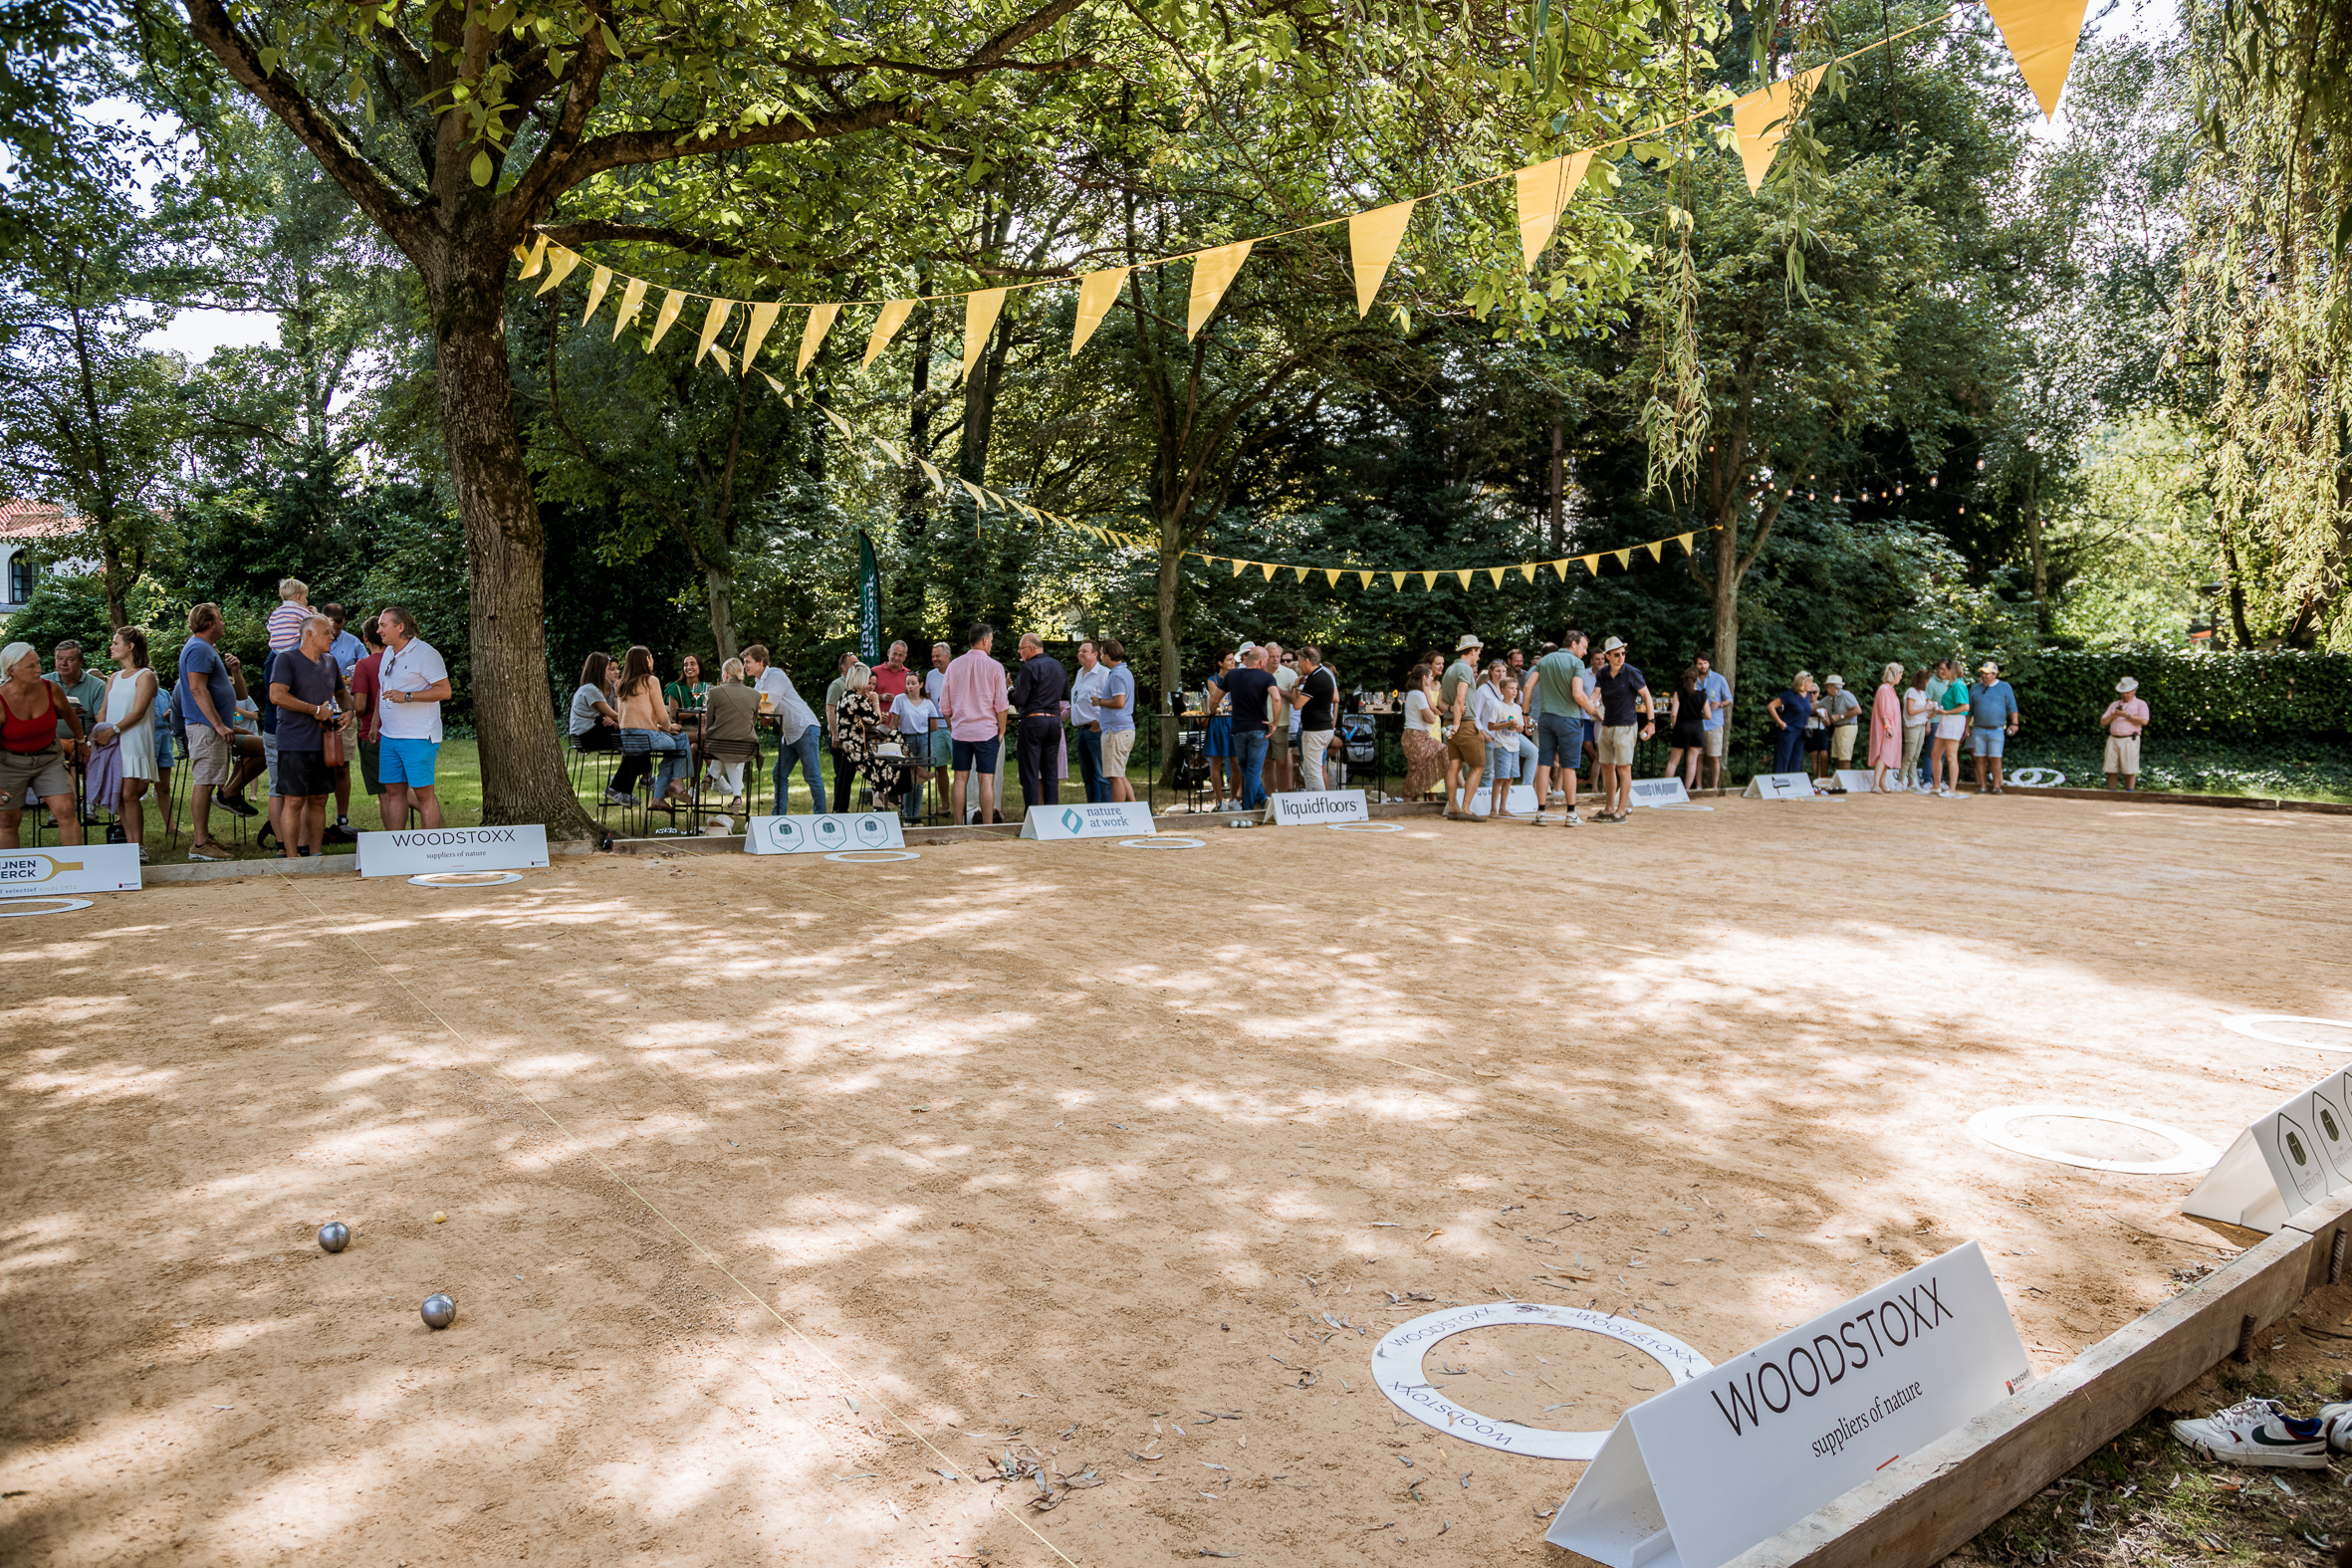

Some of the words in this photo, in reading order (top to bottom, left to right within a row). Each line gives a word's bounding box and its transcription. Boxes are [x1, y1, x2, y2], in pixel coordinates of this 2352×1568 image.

[865, 573, 874, 631] work
[1086, 806, 1122, 816] nature
[1089, 818, 1101, 827] at
[1101, 816, 1129, 827] work
[1282, 796, 1357, 818] liquidfloors
[391, 828, 516, 848] WOODSTOXX
[426, 850, 456, 860] suppliers
[465, 849, 487, 858] nature
[0, 869, 36, 879] ERCK
[1388, 1306, 1493, 1347] WOODSTOXX
[1575, 1311, 1700, 1364] WOODSTOXX
[1711, 1277, 1954, 1437] WOODSTOXX
[1387, 1381, 1513, 1447] WOODSTOXX
[1811, 1411, 1870, 1458] suppliers
[1869, 1397, 1884, 1424] of
[1883, 1381, 1923, 1410] nature
